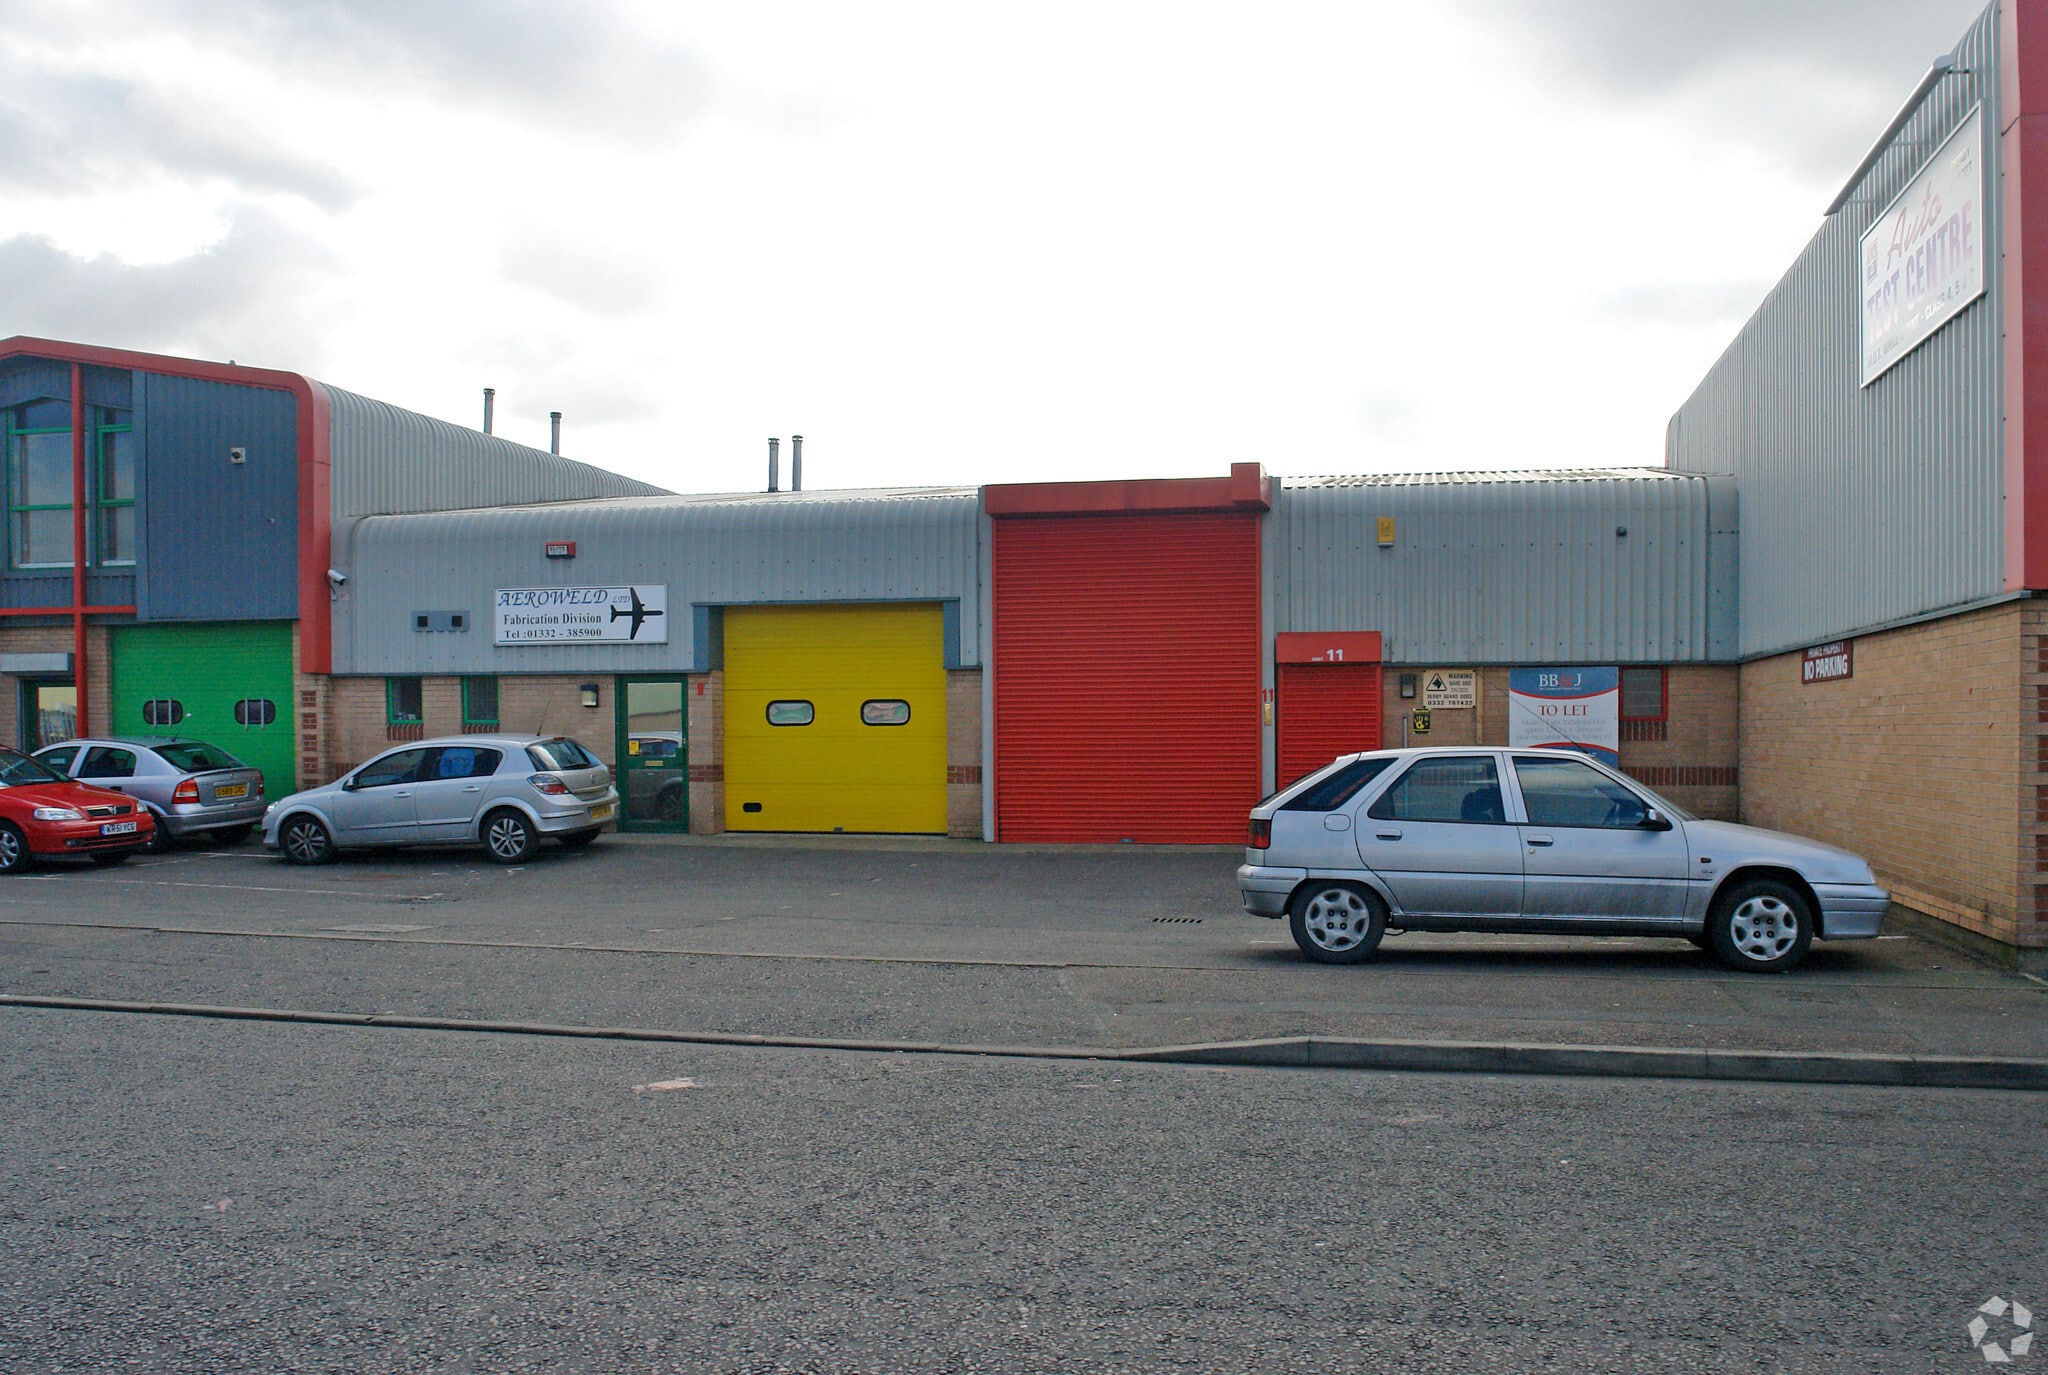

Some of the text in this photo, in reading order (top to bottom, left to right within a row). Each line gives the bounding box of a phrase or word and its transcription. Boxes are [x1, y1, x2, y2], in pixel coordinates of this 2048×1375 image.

[1887, 181, 1943, 271] Auto
[1866, 199, 1974, 346] TEST CENTRE
[497, 588, 630, 609] AEROWELD LTD
[503, 612, 602, 625] Fabrication Division
[567, 629, 602, 637] 385900
[1326, 649, 1343, 661] 11
[1804, 654, 1848, 681] NO PARKING
[1262, 688, 1274, 702] 11
[1538, 704, 1590, 717] TO LET
